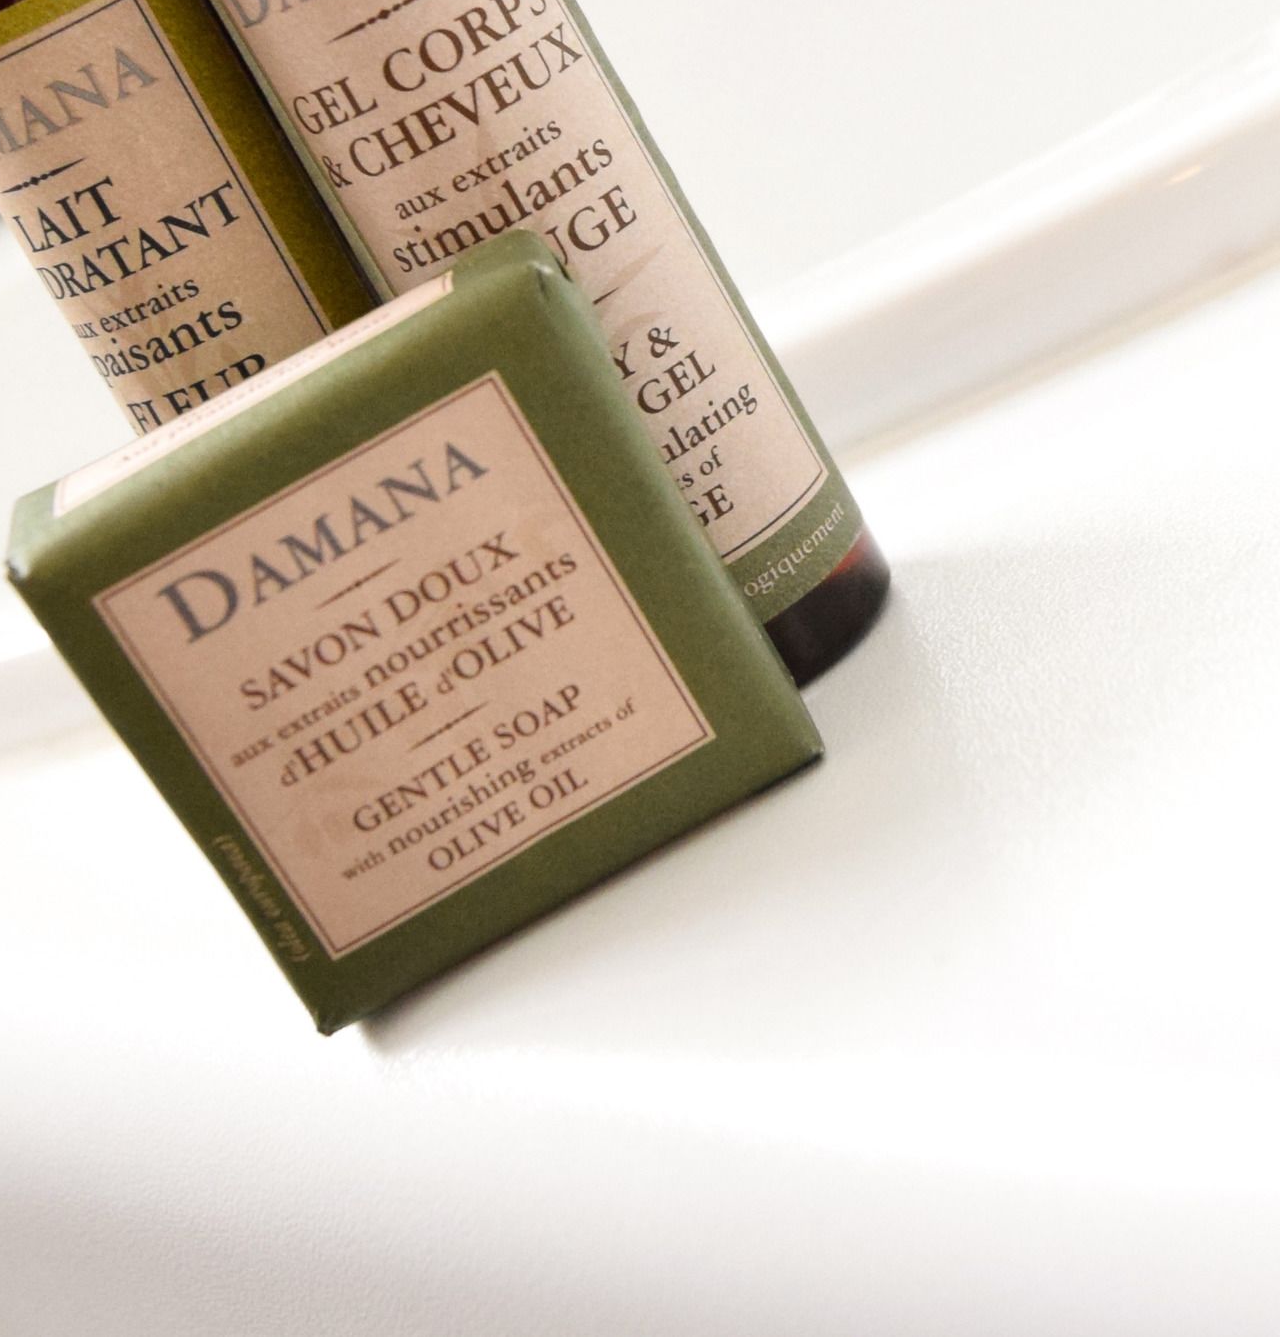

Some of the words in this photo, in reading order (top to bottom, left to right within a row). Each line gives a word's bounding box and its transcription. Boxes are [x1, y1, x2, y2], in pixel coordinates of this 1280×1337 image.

[293, 76, 379, 135] GEL
[322, 156, 353, 188] &
[349, 22, 583, 177] CHEVEUX
[12, 175, 121, 253] LAIT
[393, 139, 613, 273] stimulants
[395, 186, 447, 220] aux
[452, 120, 562, 193] extraits
[100, 279, 200, 333] extraits
[647, 327, 680, 359] &
[637, 350, 716, 414] GEL
[699, 445, 723, 476] of
[157, 442, 489, 644] DAMANA
[230, 737, 275, 767] aux
[278, 687, 361, 739] extraits
[364, 553, 577, 688] nourrissants
[240, 611, 381, 710] SAVON
[384, 532, 520, 625] DOUX
[281, 682, 428, 786] d'HUILE
[437, 595, 575, 694] d'OLIVE
[342, 851, 386, 880] with
[388, 759, 536, 855] nourishing
[541, 720, 612, 764] extracts
[616, 698, 634, 720] of
[353, 738, 491, 832] GENTLE
[493, 684, 580, 749] SOAP
[428, 801, 525, 871] OLIVE
[529, 769, 588, 809] OIL
